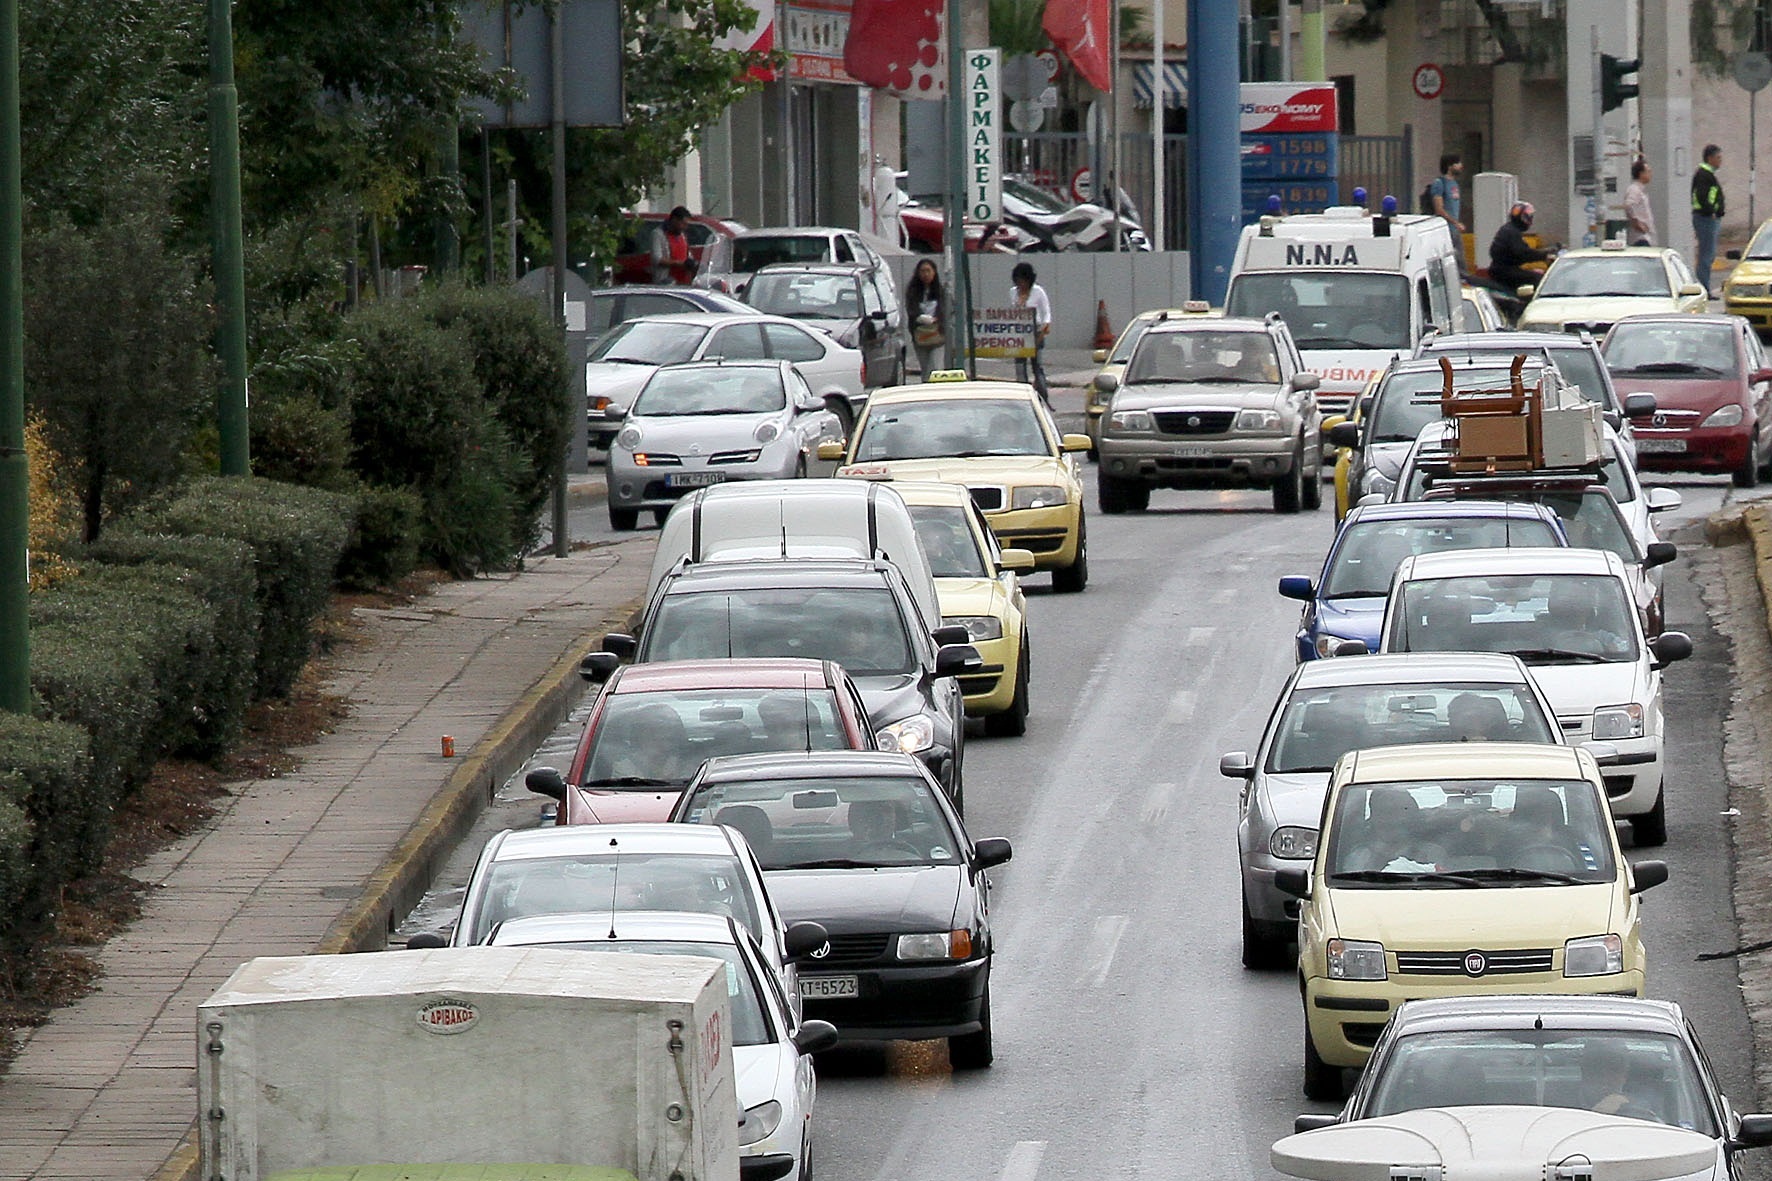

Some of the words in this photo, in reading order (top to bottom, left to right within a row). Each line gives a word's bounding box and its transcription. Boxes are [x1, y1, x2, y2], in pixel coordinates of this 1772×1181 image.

[970, 54, 991, 221] ΦΑΡΜΑΚΕΙΟ
[1286, 245, 1359, 265] N.N.A
[974, 323, 1033, 333] ΥΝΕΡΓΕΙΟ
